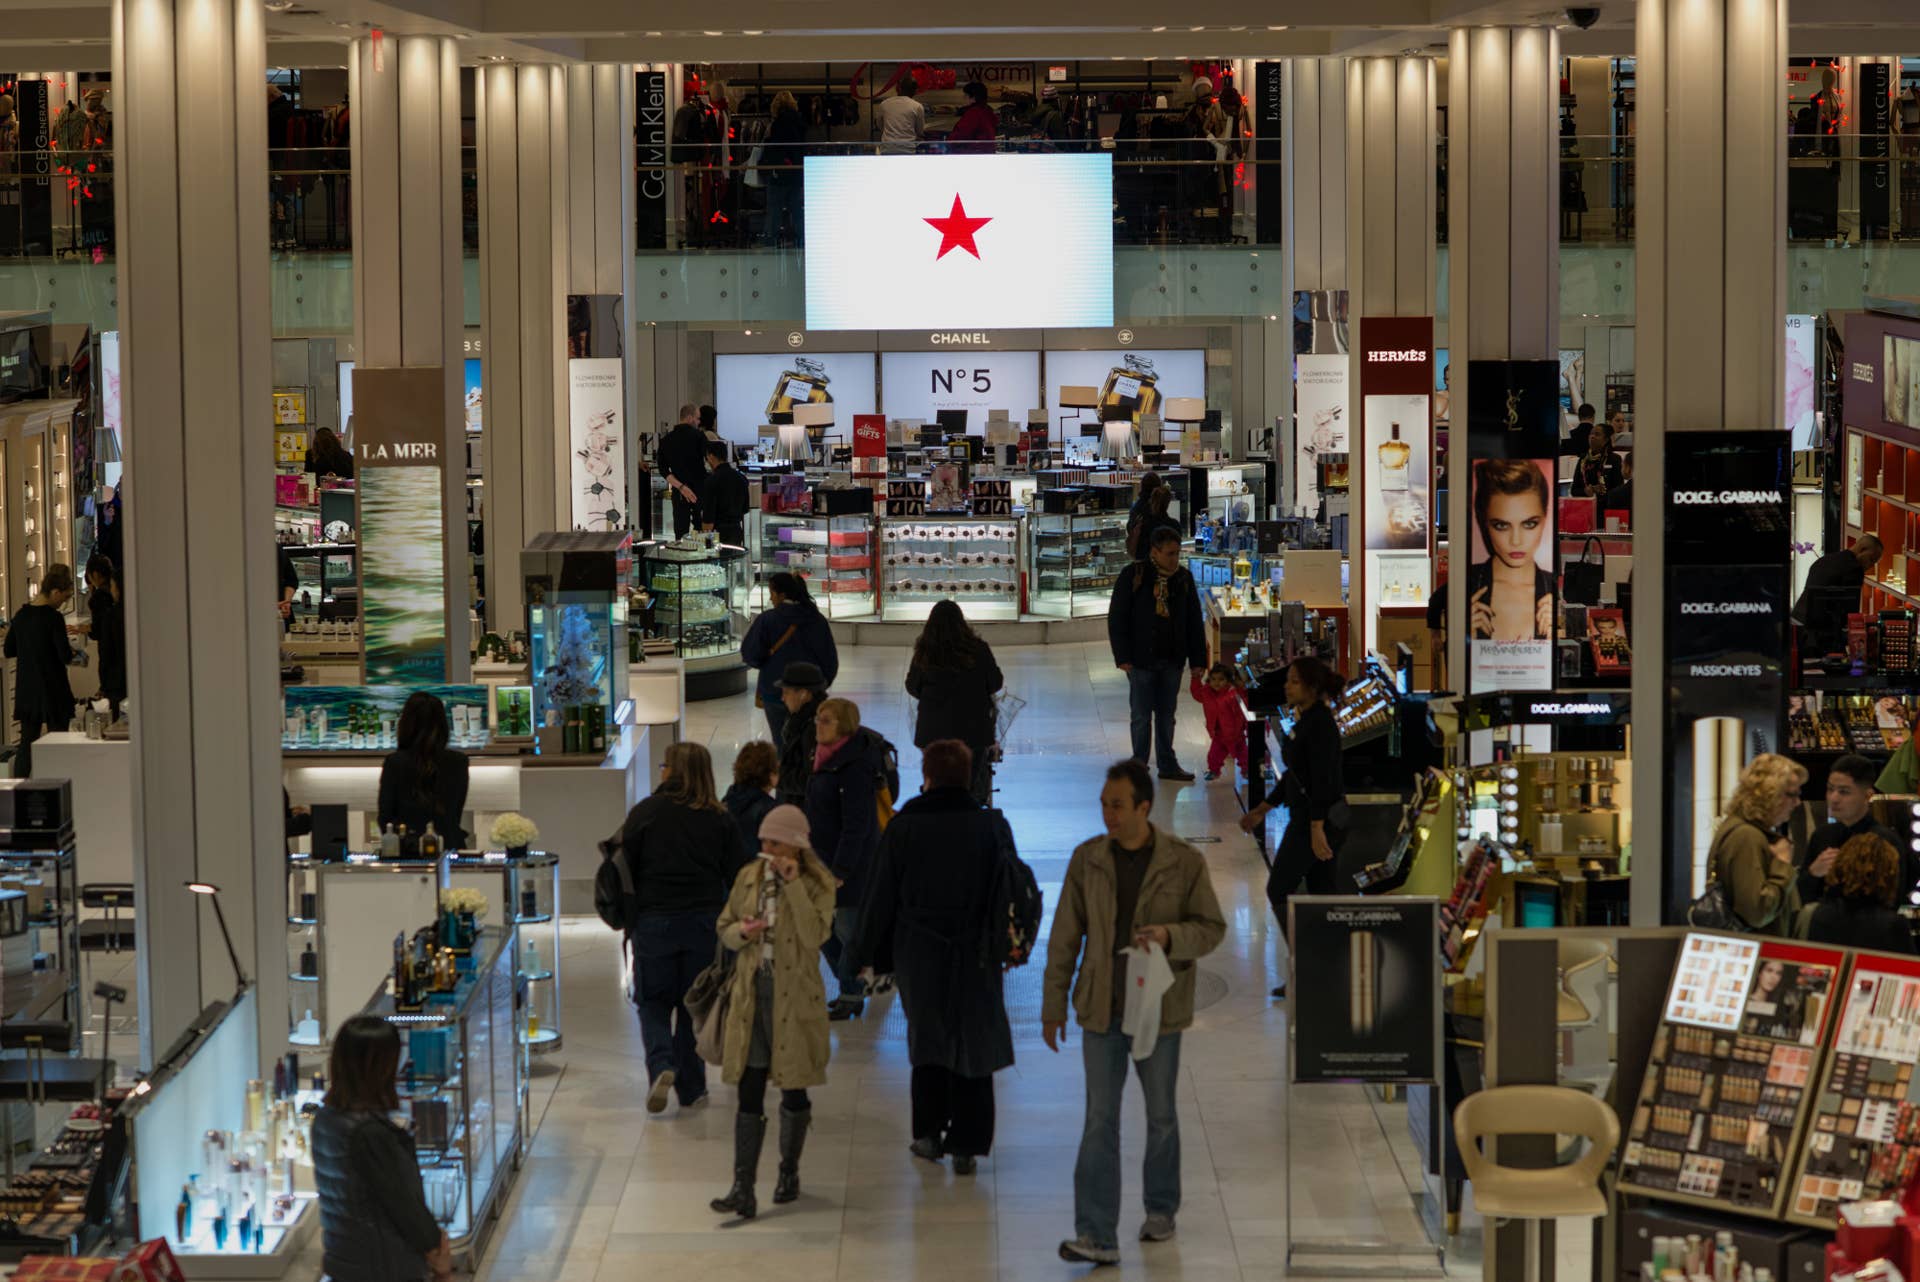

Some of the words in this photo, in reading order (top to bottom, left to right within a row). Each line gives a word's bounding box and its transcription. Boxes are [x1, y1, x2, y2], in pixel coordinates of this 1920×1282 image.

[966, 65, 1031, 82] warm
[640, 75, 665, 126] Klein
[930, 332, 991, 344] CHANEL
[360, 443, 389, 460] LA
[392, 442, 438, 459] MER
